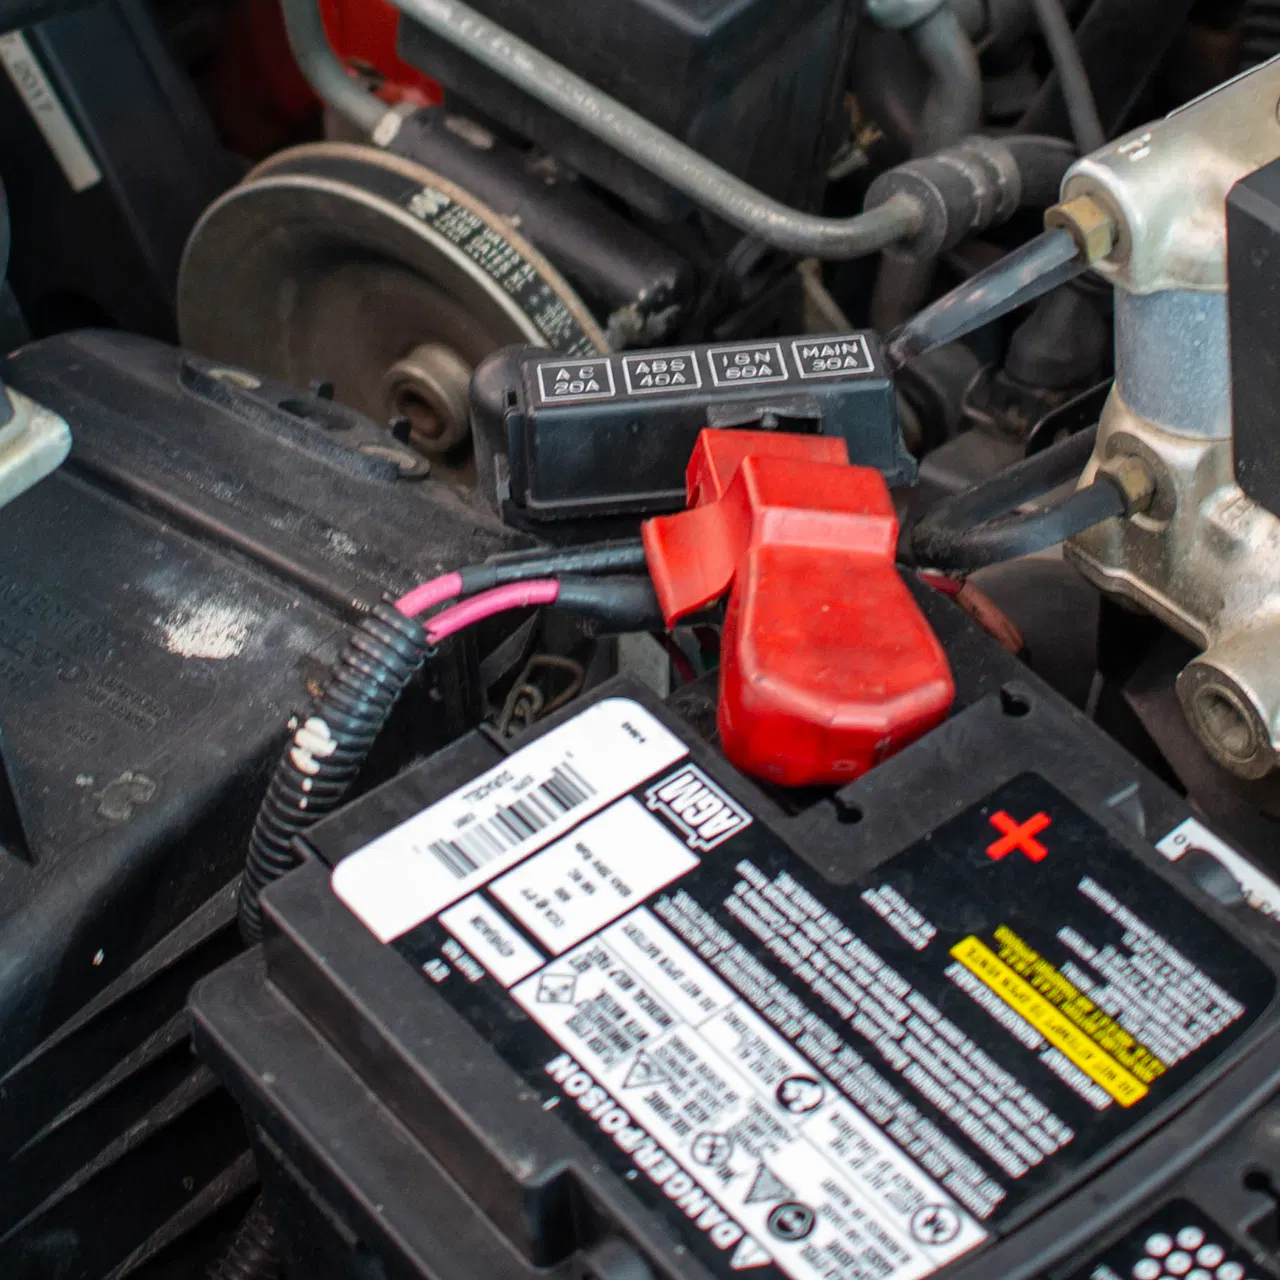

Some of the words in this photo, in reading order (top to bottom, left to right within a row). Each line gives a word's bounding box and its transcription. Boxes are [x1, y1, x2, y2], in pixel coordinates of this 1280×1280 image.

[802, 341, 859, 359] MAIN
[635, 358, 686, 375] ABS
[812, 355, 858, 371] 30A
[553, 379, 600, 395] 20A
[639, 371, 687, 387] 40A
[462, 770, 514, 800] DURACELL
[654, 770, 744, 843] AGM
[423, 959, 450, 982] 12V
[546, 1054, 743, 1249] DANGER/POISON
